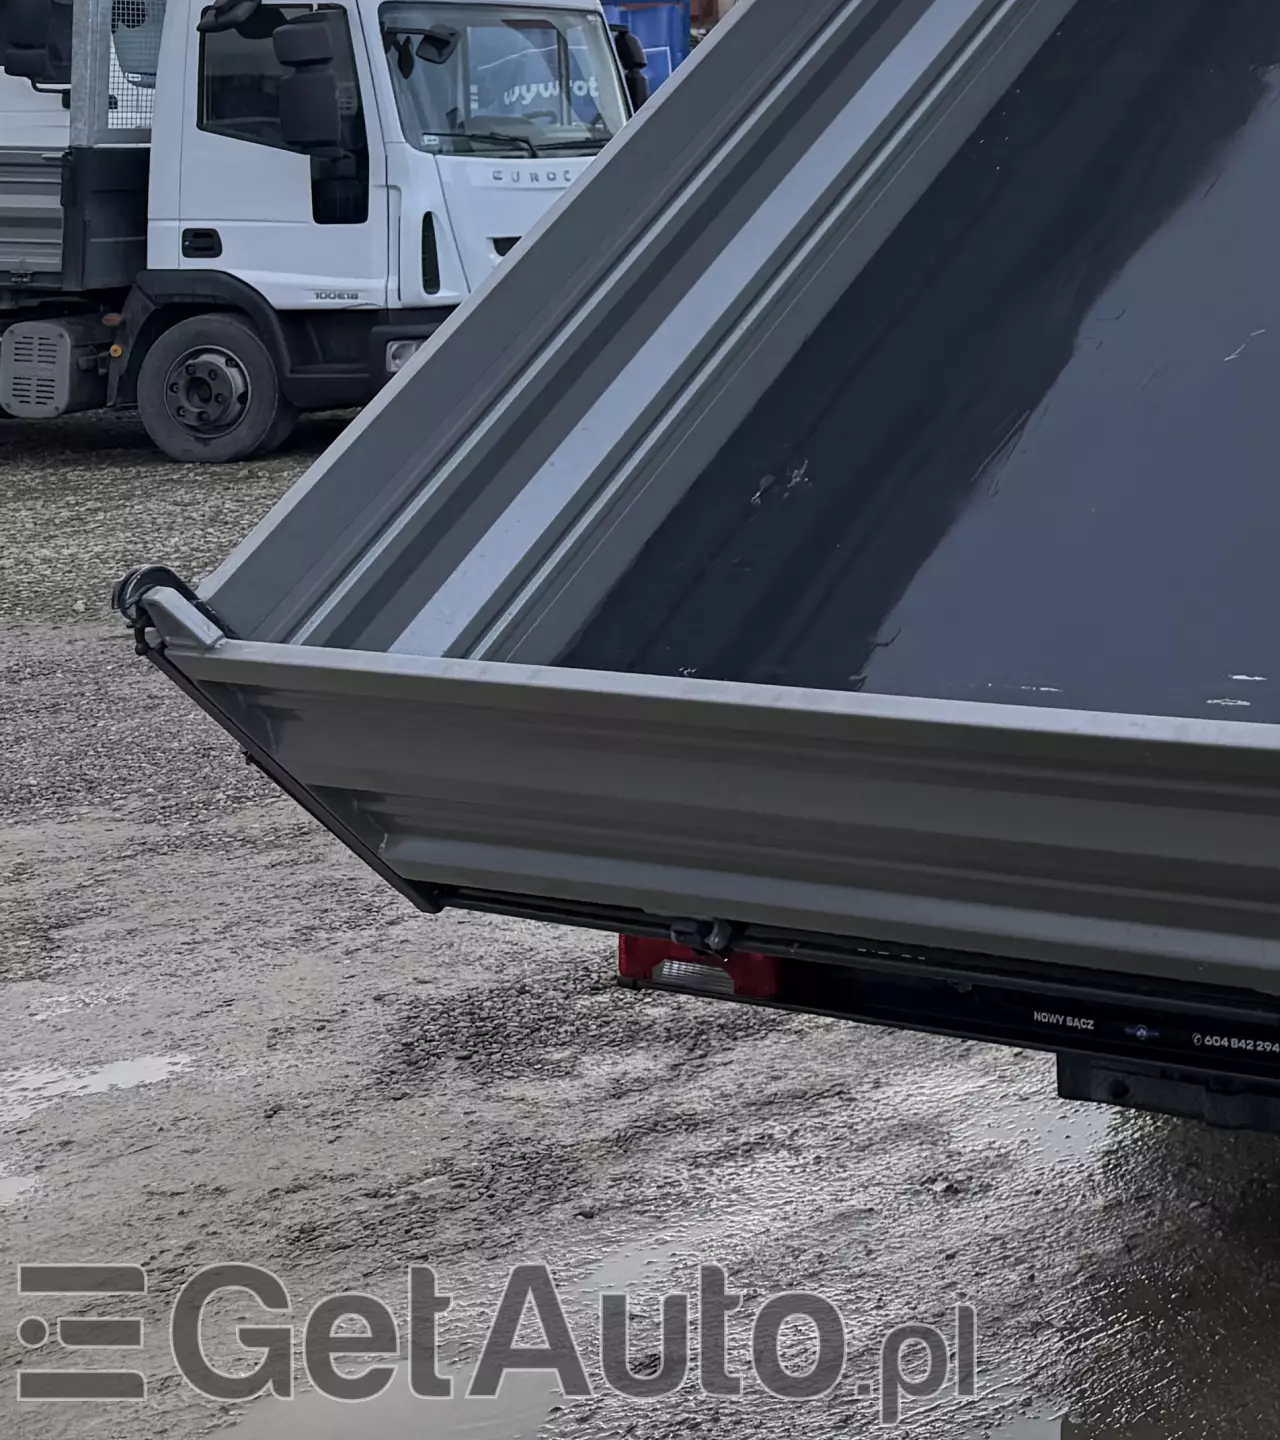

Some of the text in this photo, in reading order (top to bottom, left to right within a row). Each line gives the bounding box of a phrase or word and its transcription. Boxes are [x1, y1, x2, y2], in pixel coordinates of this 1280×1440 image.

[503, 76, 599, 105] wywot
[1033, 1011, 1095, 1031] NOWY SĄCZ
[1204, 1035, 1280, 1054] 604 842 294
